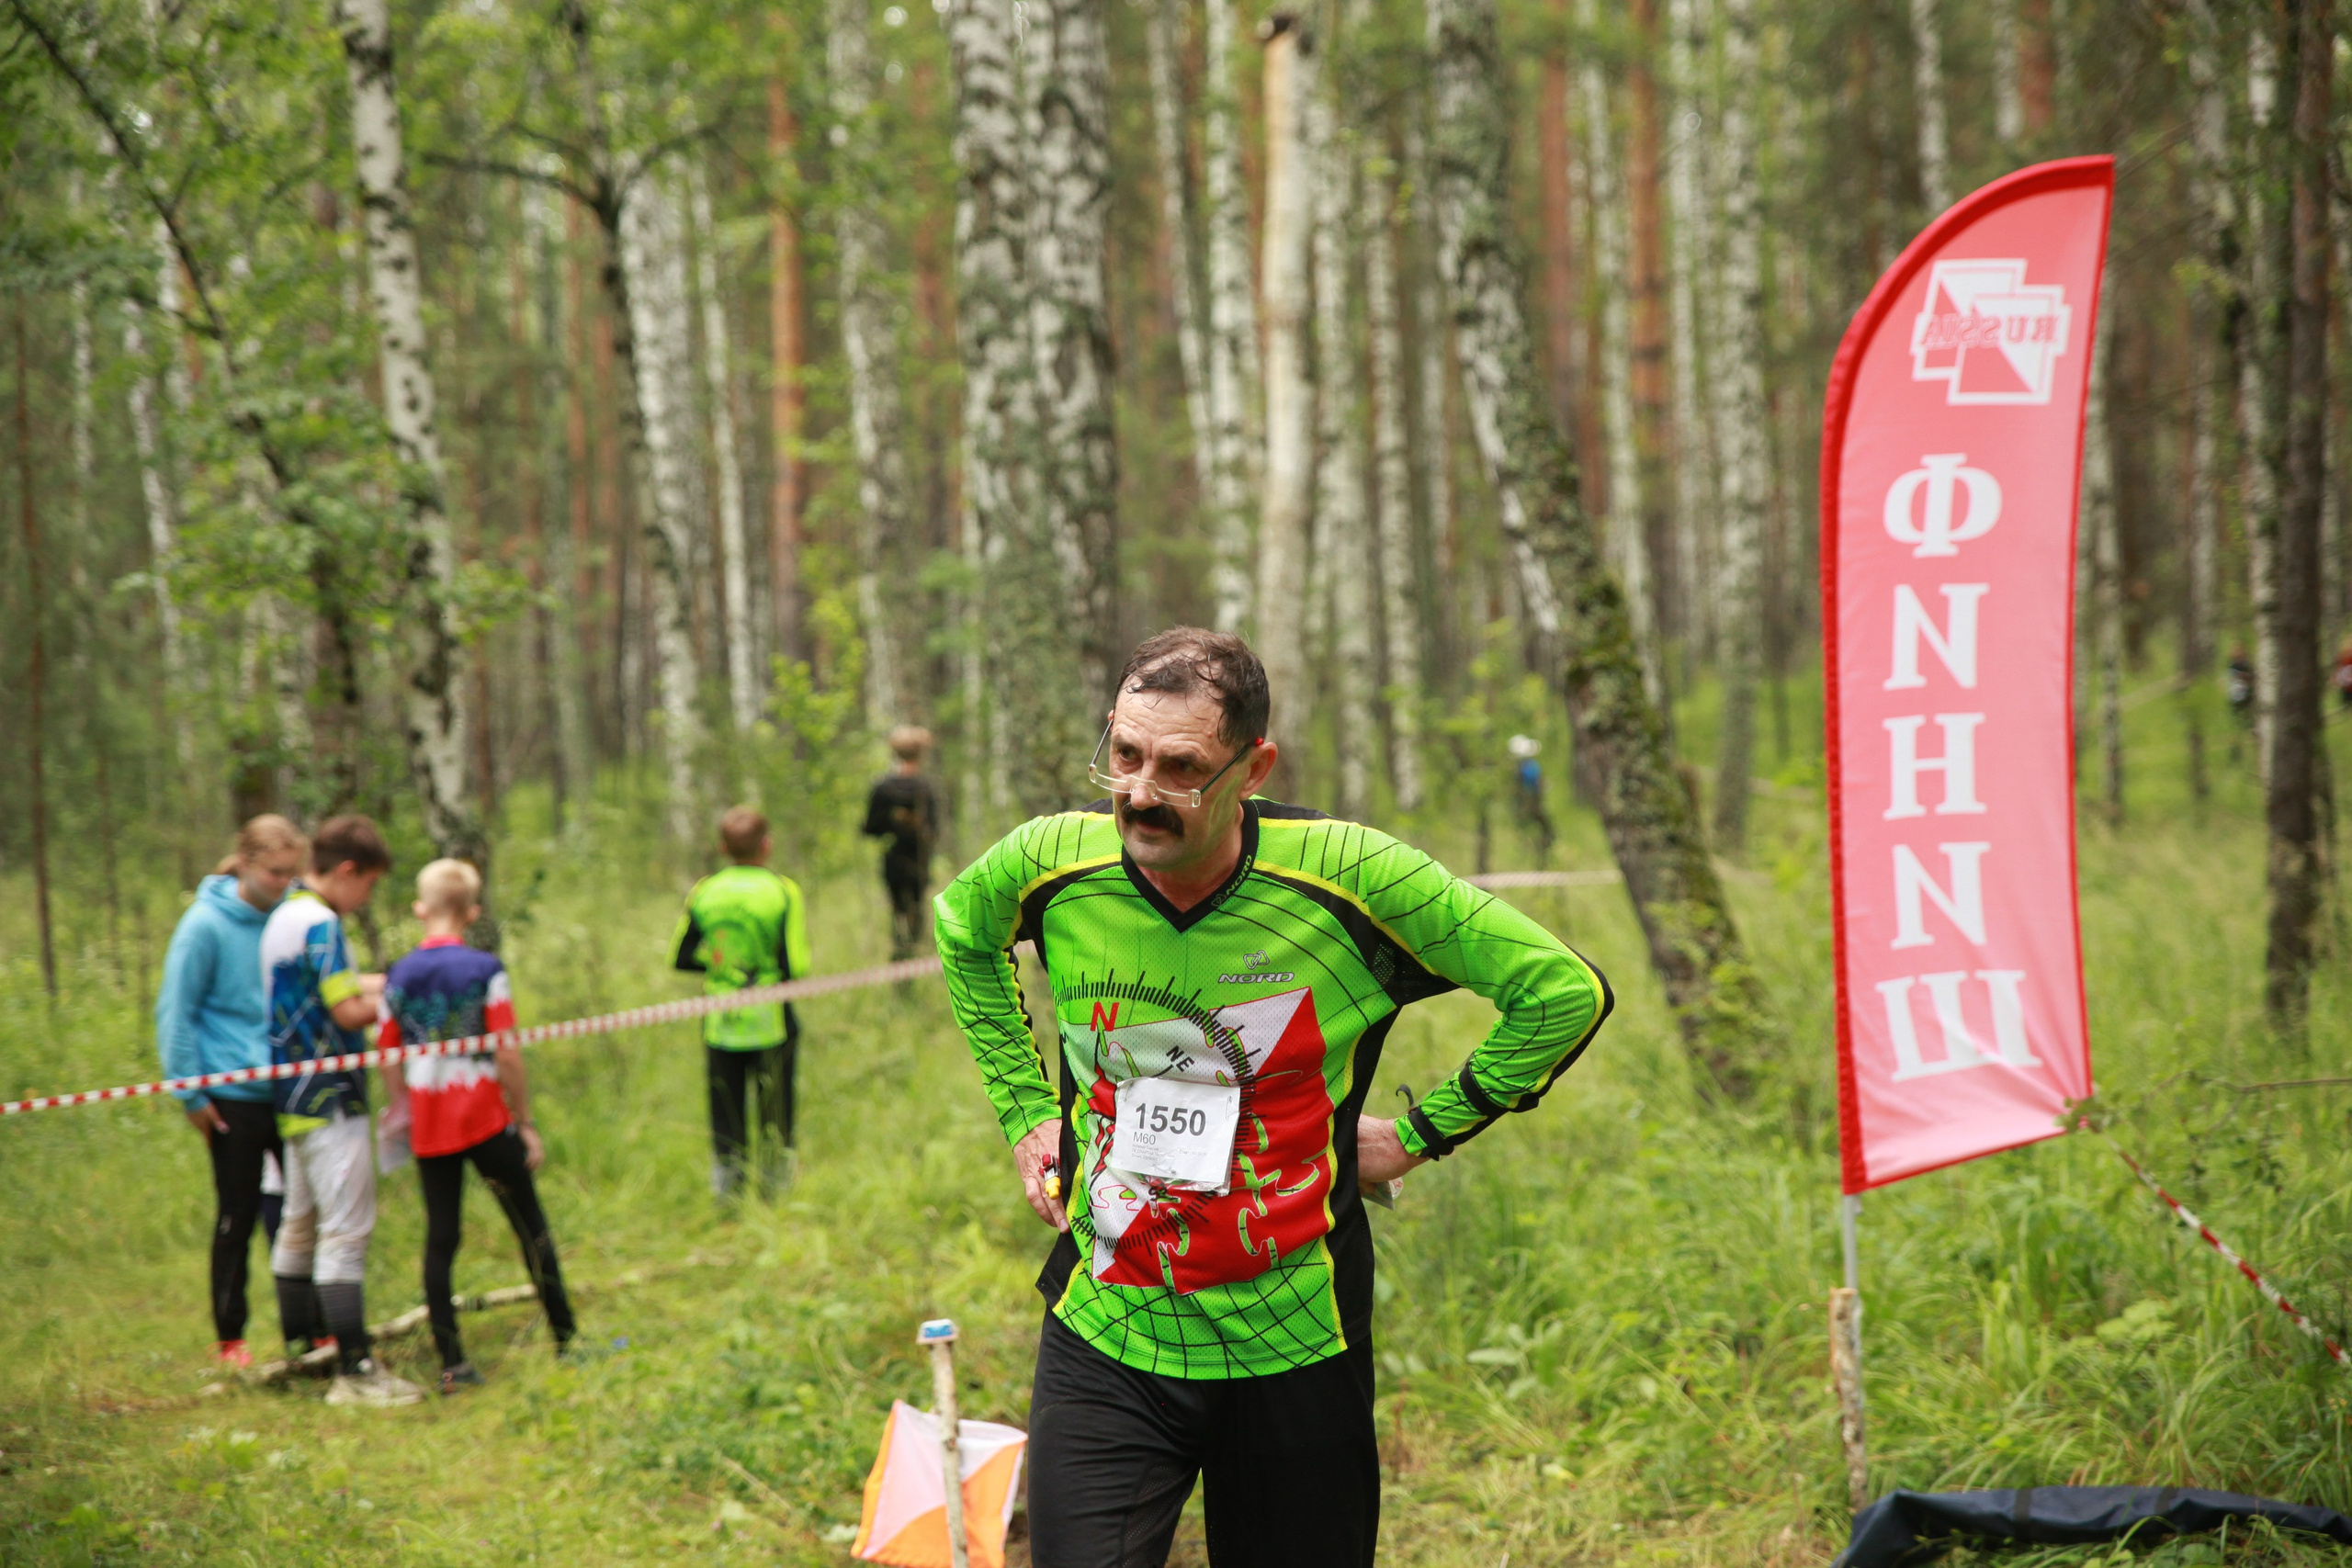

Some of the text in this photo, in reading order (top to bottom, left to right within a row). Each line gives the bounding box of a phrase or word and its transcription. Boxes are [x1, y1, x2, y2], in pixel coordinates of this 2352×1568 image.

[1226, 854, 1252, 896] NORD
[1217, 972, 1295, 984] NORD
[1090, 1001, 1120, 1032] N
[1166, 1045, 1194, 1072] NE
[1136, 1102, 1206, 1137] 1550
[1133, 1131, 1157, 1145] M60
